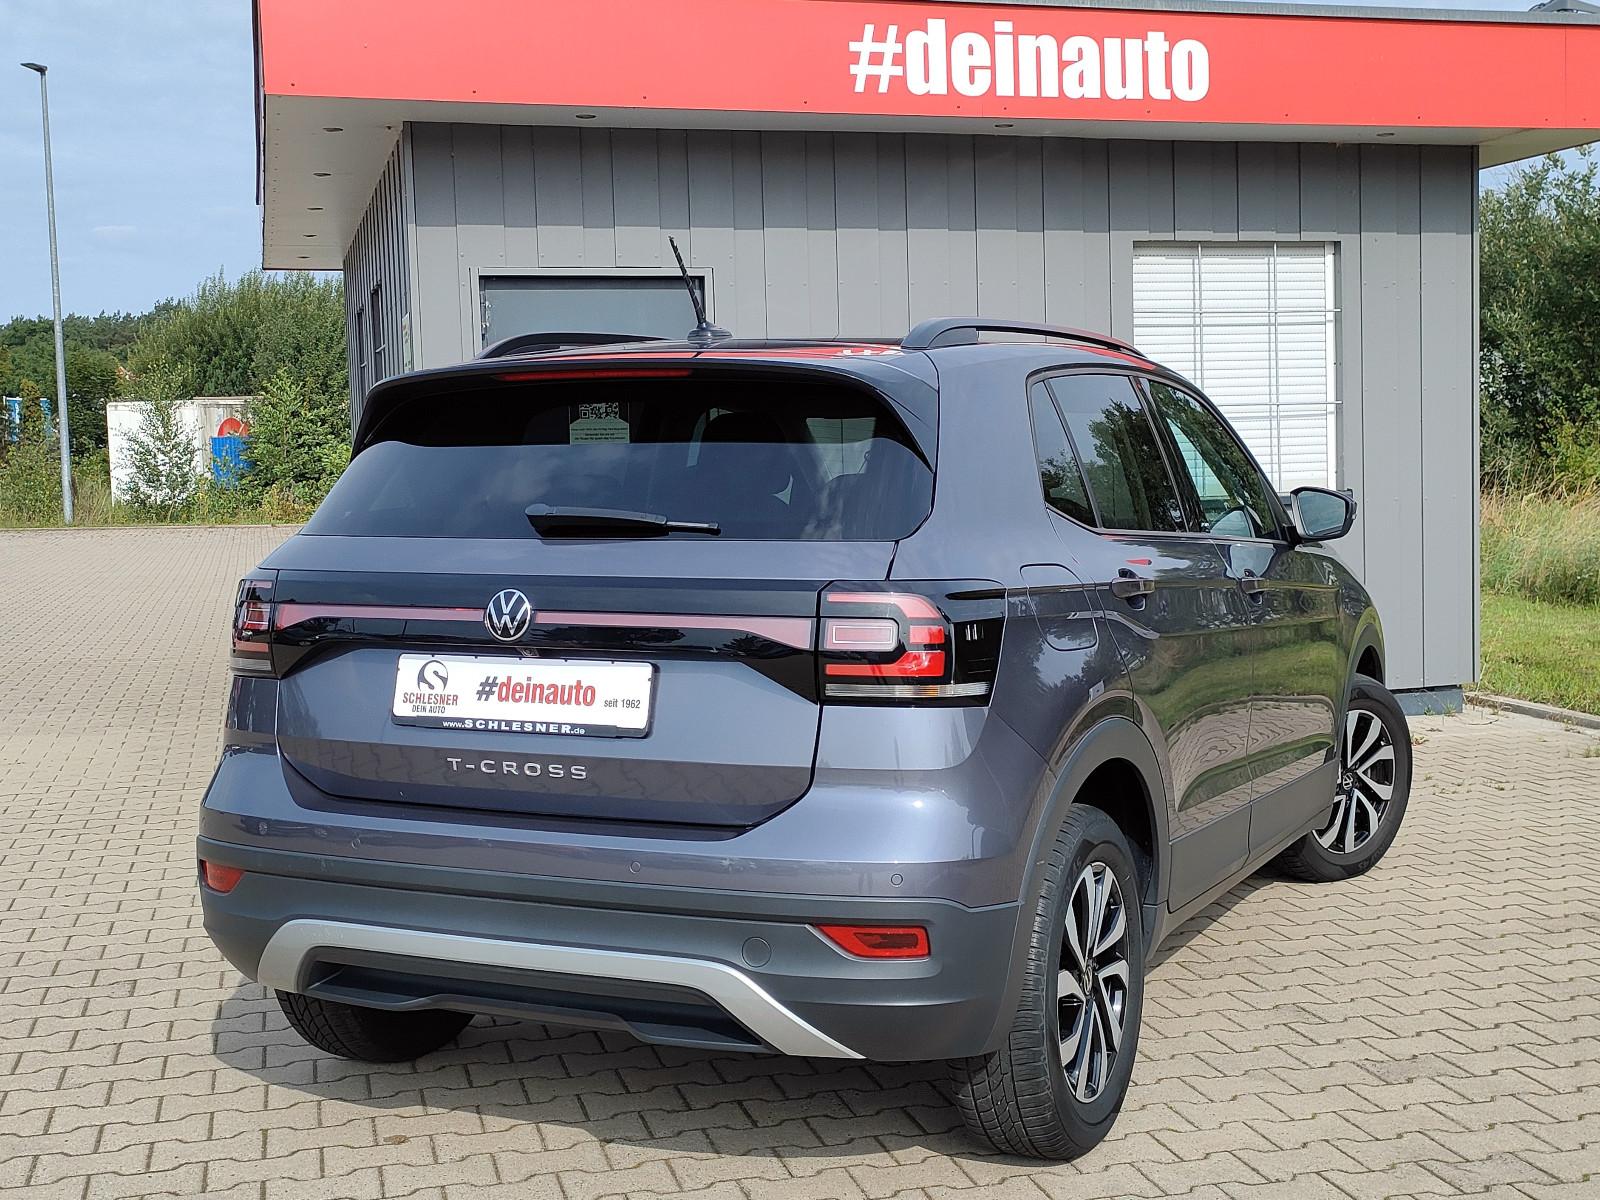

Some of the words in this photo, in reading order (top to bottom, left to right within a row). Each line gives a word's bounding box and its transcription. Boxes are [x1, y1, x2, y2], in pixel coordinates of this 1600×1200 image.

[848, 17, 1210, 102] #deinauto
[402, 692, 459, 706] SCHLESNER
[476, 675, 596, 707] #deinauto
[411, 704, 427, 713] DEIN
[428, 705, 446, 714] AUTO
[603, 699, 618, 708] seit
[621, 699, 641, 709] 1962
[442, 719, 586, 735] www.SCHLESNER.de
[446, 757, 587, 780] T-CROSS
